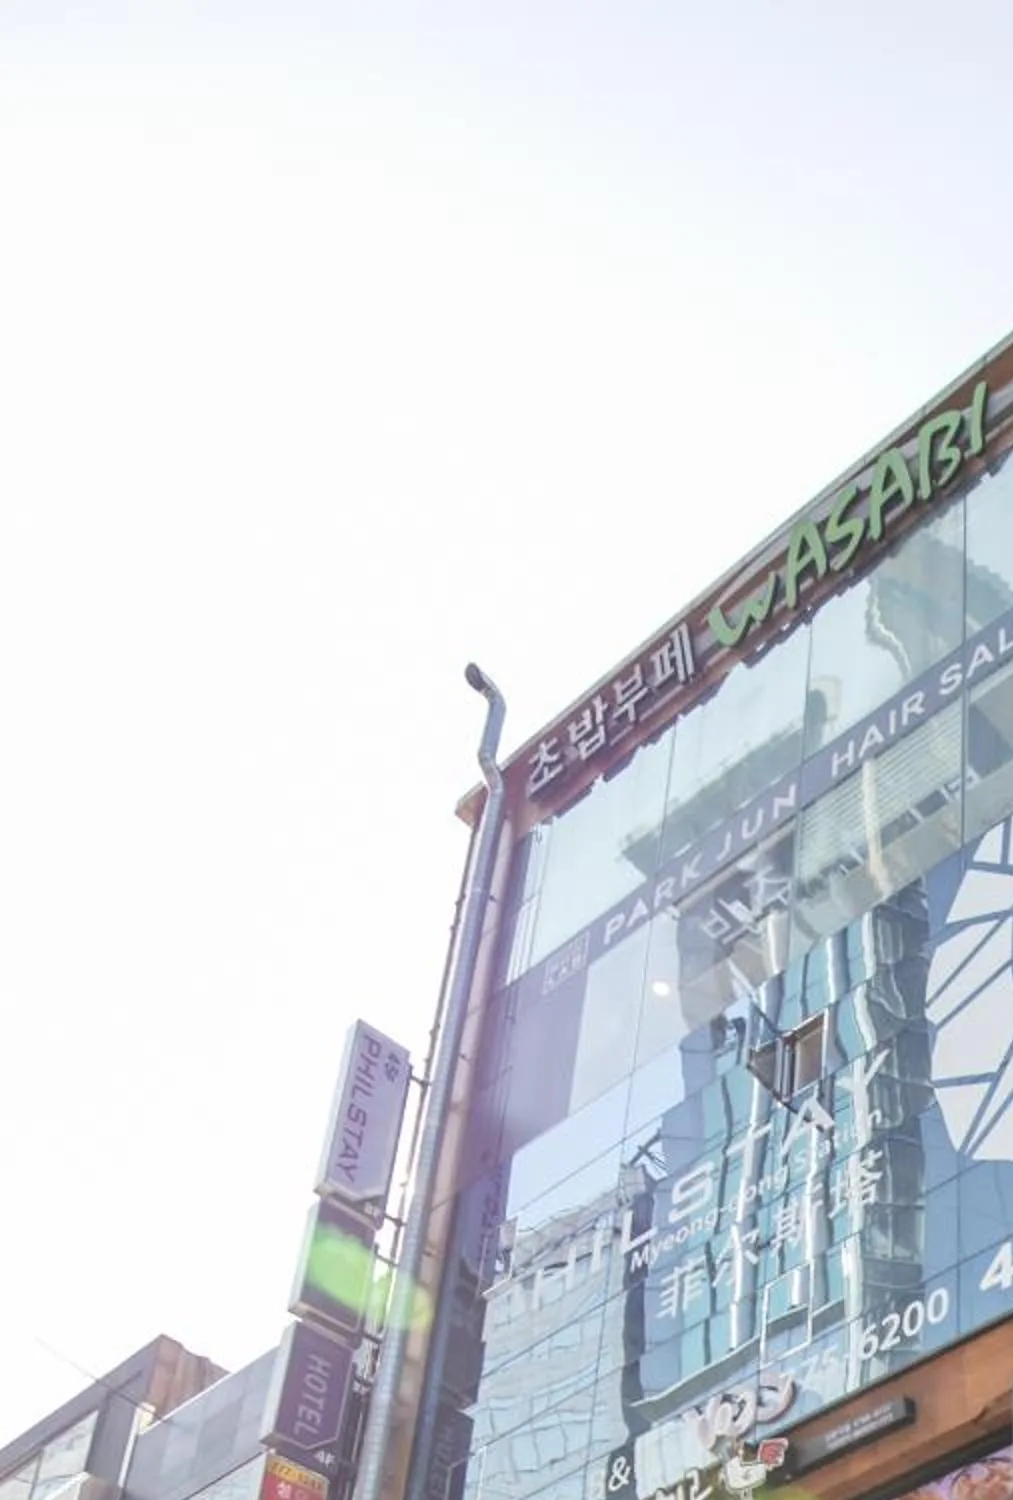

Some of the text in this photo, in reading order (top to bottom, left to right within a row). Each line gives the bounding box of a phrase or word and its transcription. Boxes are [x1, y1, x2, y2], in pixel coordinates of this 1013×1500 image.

[526, 626, 696, 796] 초밥부페
[603, 856, 700, 946] PARK
[716, 784, 796, 861] JUN
[831, 690, 926, 779] HAIR
[335, 1032, 383, 1184] PHILSTAY
[293, 1353, 333, 1436] HOTEL
